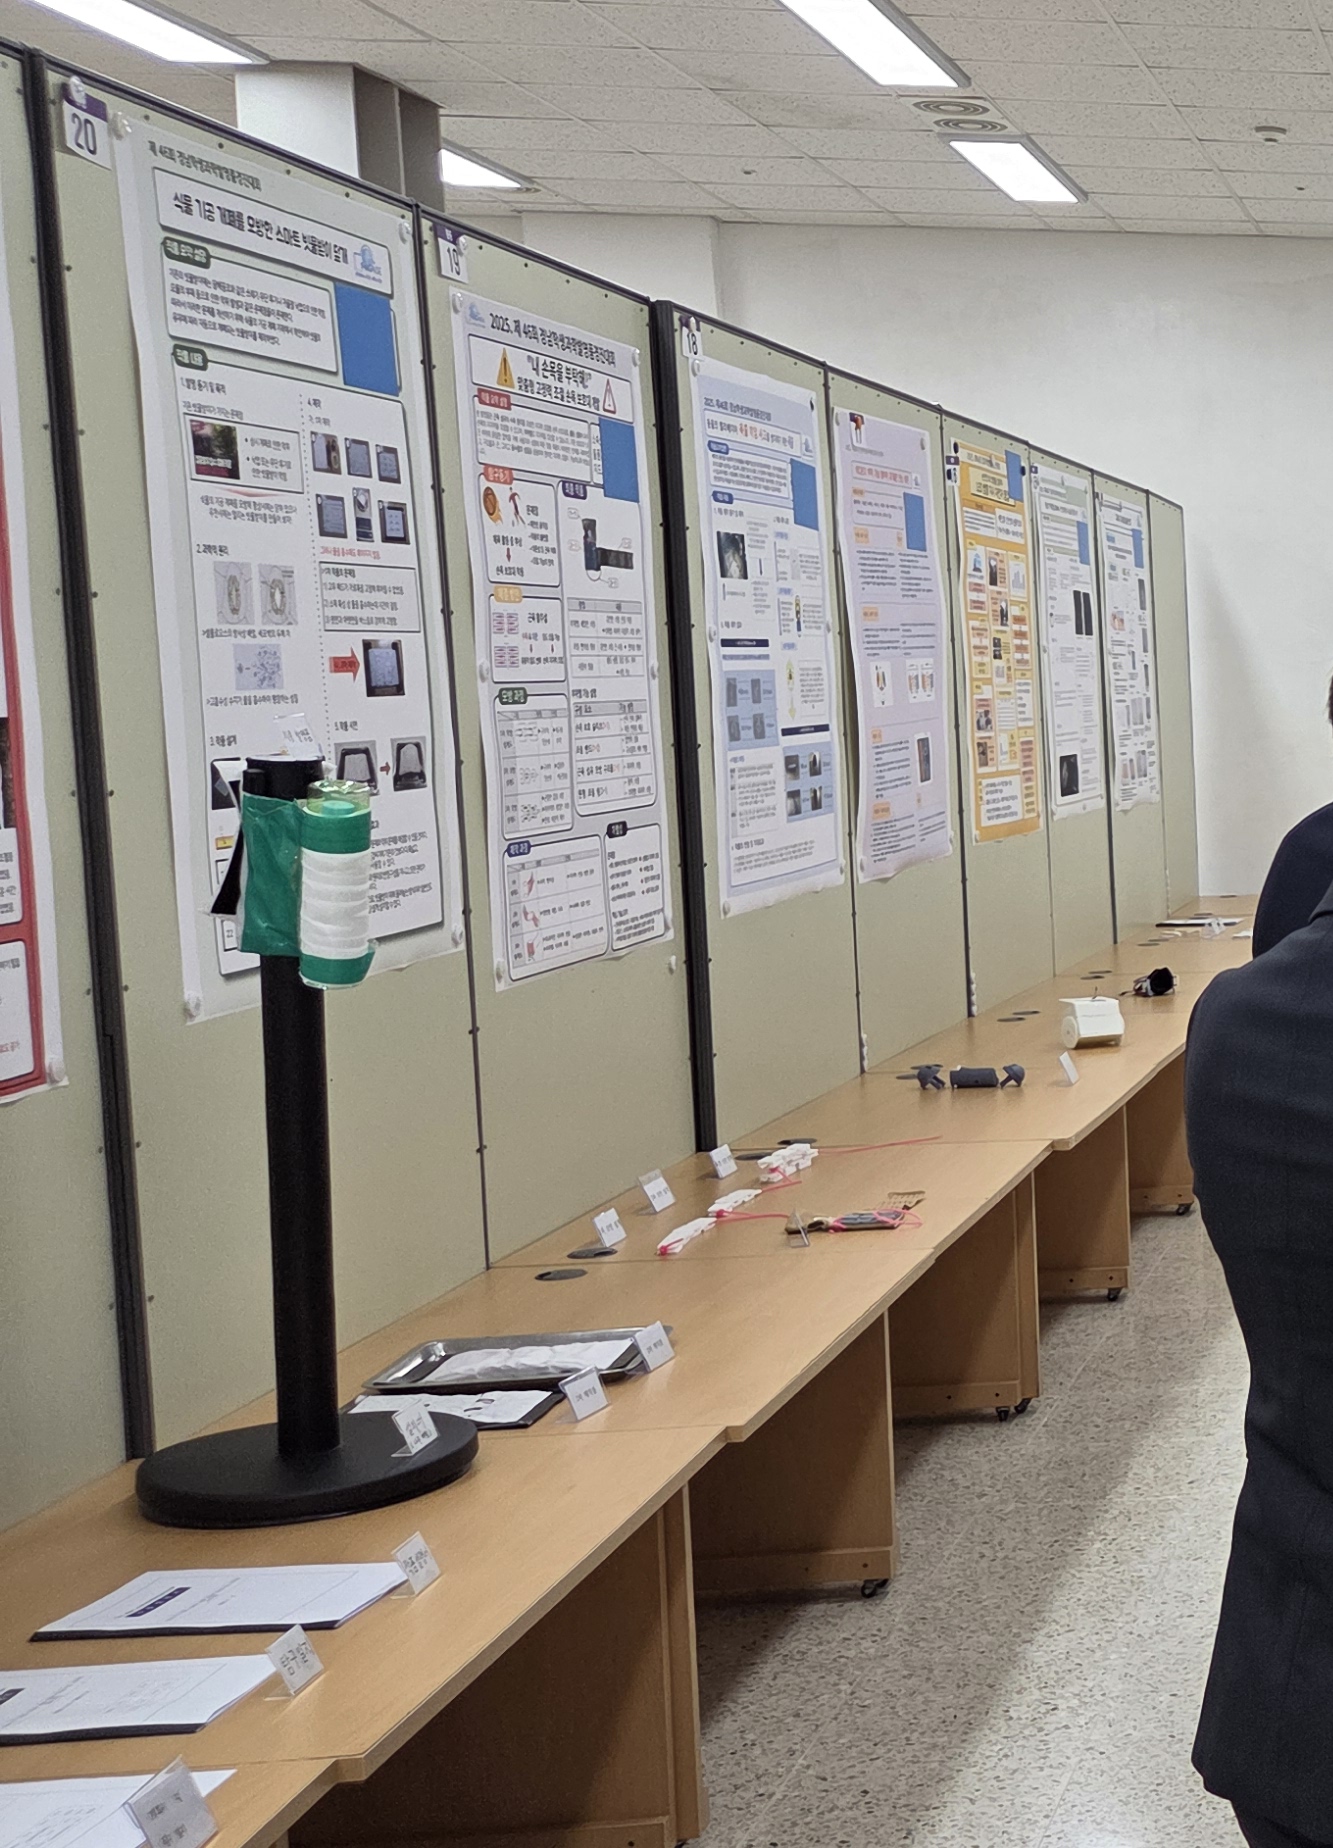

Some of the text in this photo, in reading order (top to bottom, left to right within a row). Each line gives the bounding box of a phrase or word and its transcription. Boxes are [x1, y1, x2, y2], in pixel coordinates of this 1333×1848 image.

[71, 115, 96, 155] 20
[447, 246, 460, 276] 19
[686, 332, 698, 355] 18
